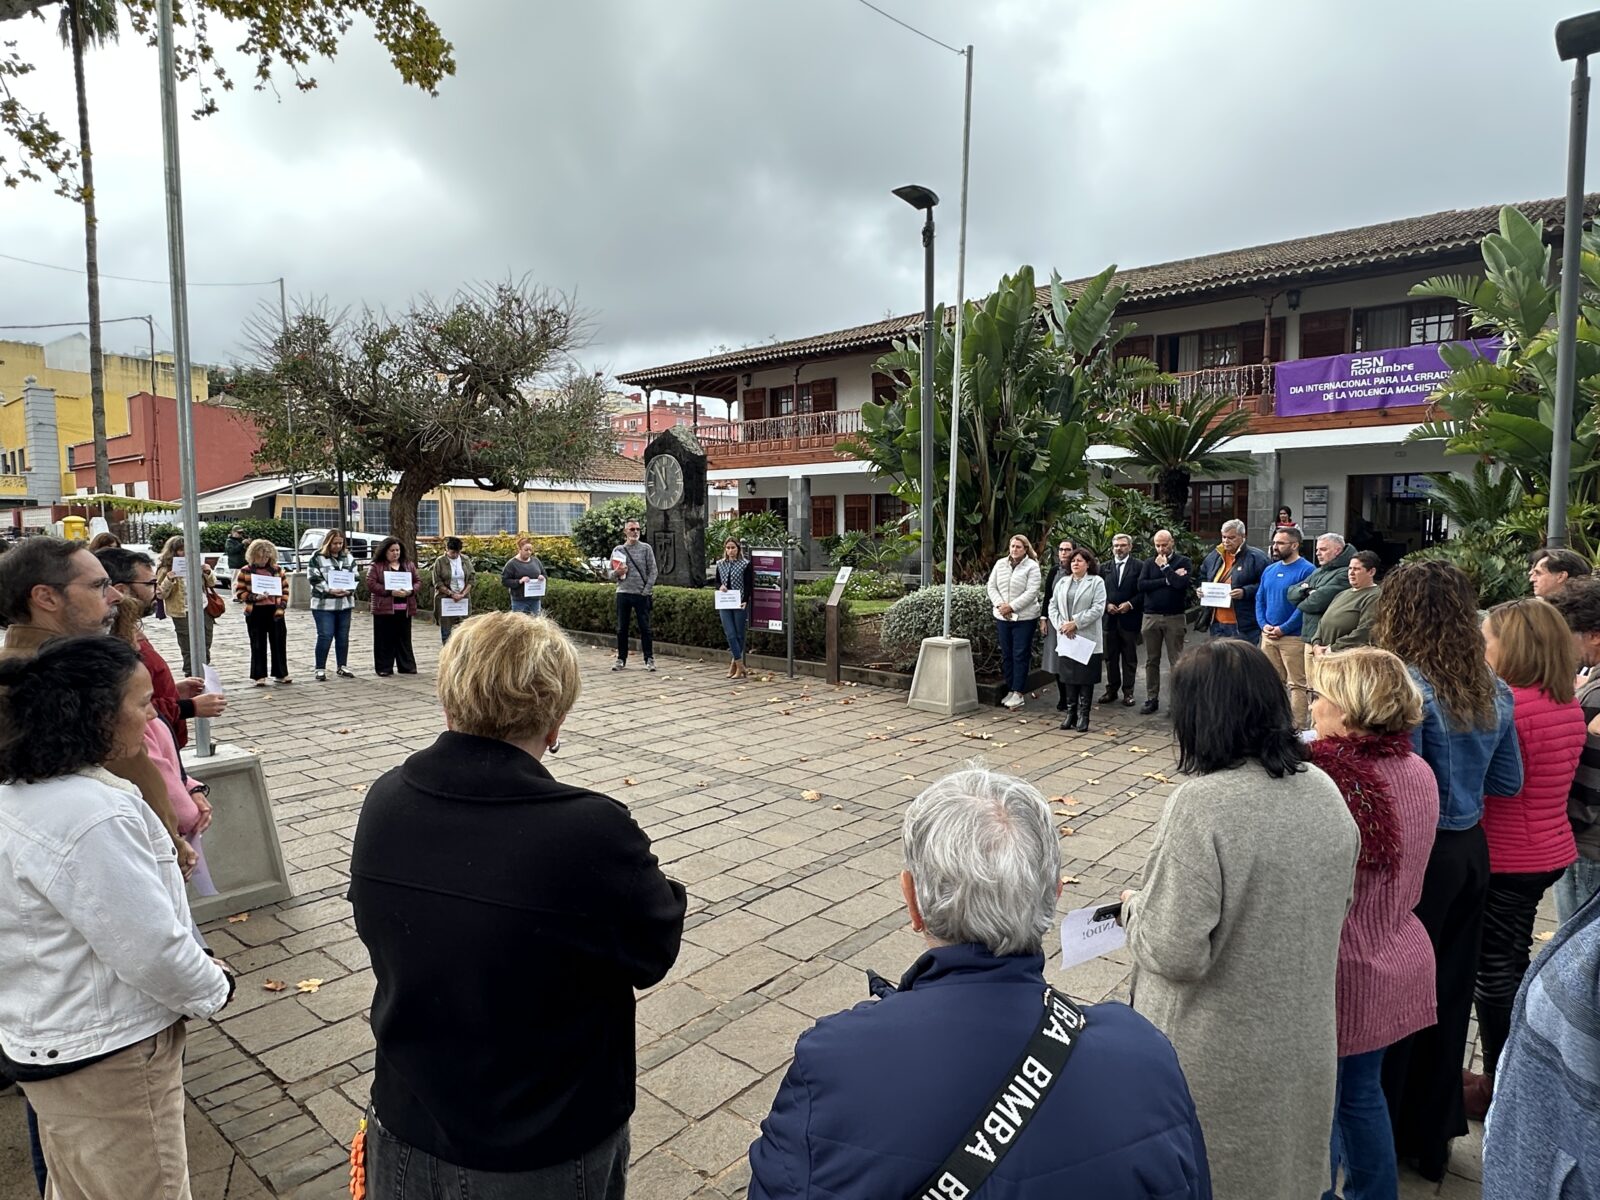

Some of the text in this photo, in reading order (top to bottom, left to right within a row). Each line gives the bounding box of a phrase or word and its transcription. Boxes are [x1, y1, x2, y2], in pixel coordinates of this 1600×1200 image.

[1350, 363, 1415, 376] noviembre
[1351, 356, 1384, 370] 25N
[1305, 378, 1372, 392] INTERNACIONAL
[1373, 375, 1399, 385] PARA
[1400, 374, 1413, 383] LA
[1323, 392, 1334, 401] DE
[1335, 391, 1347, 399] LA
[1348, 386, 1394, 398] VIOLENCIA
[964, 1055, 1053, 1163] BIMBA
[921, 1171, 970, 1200] BI
